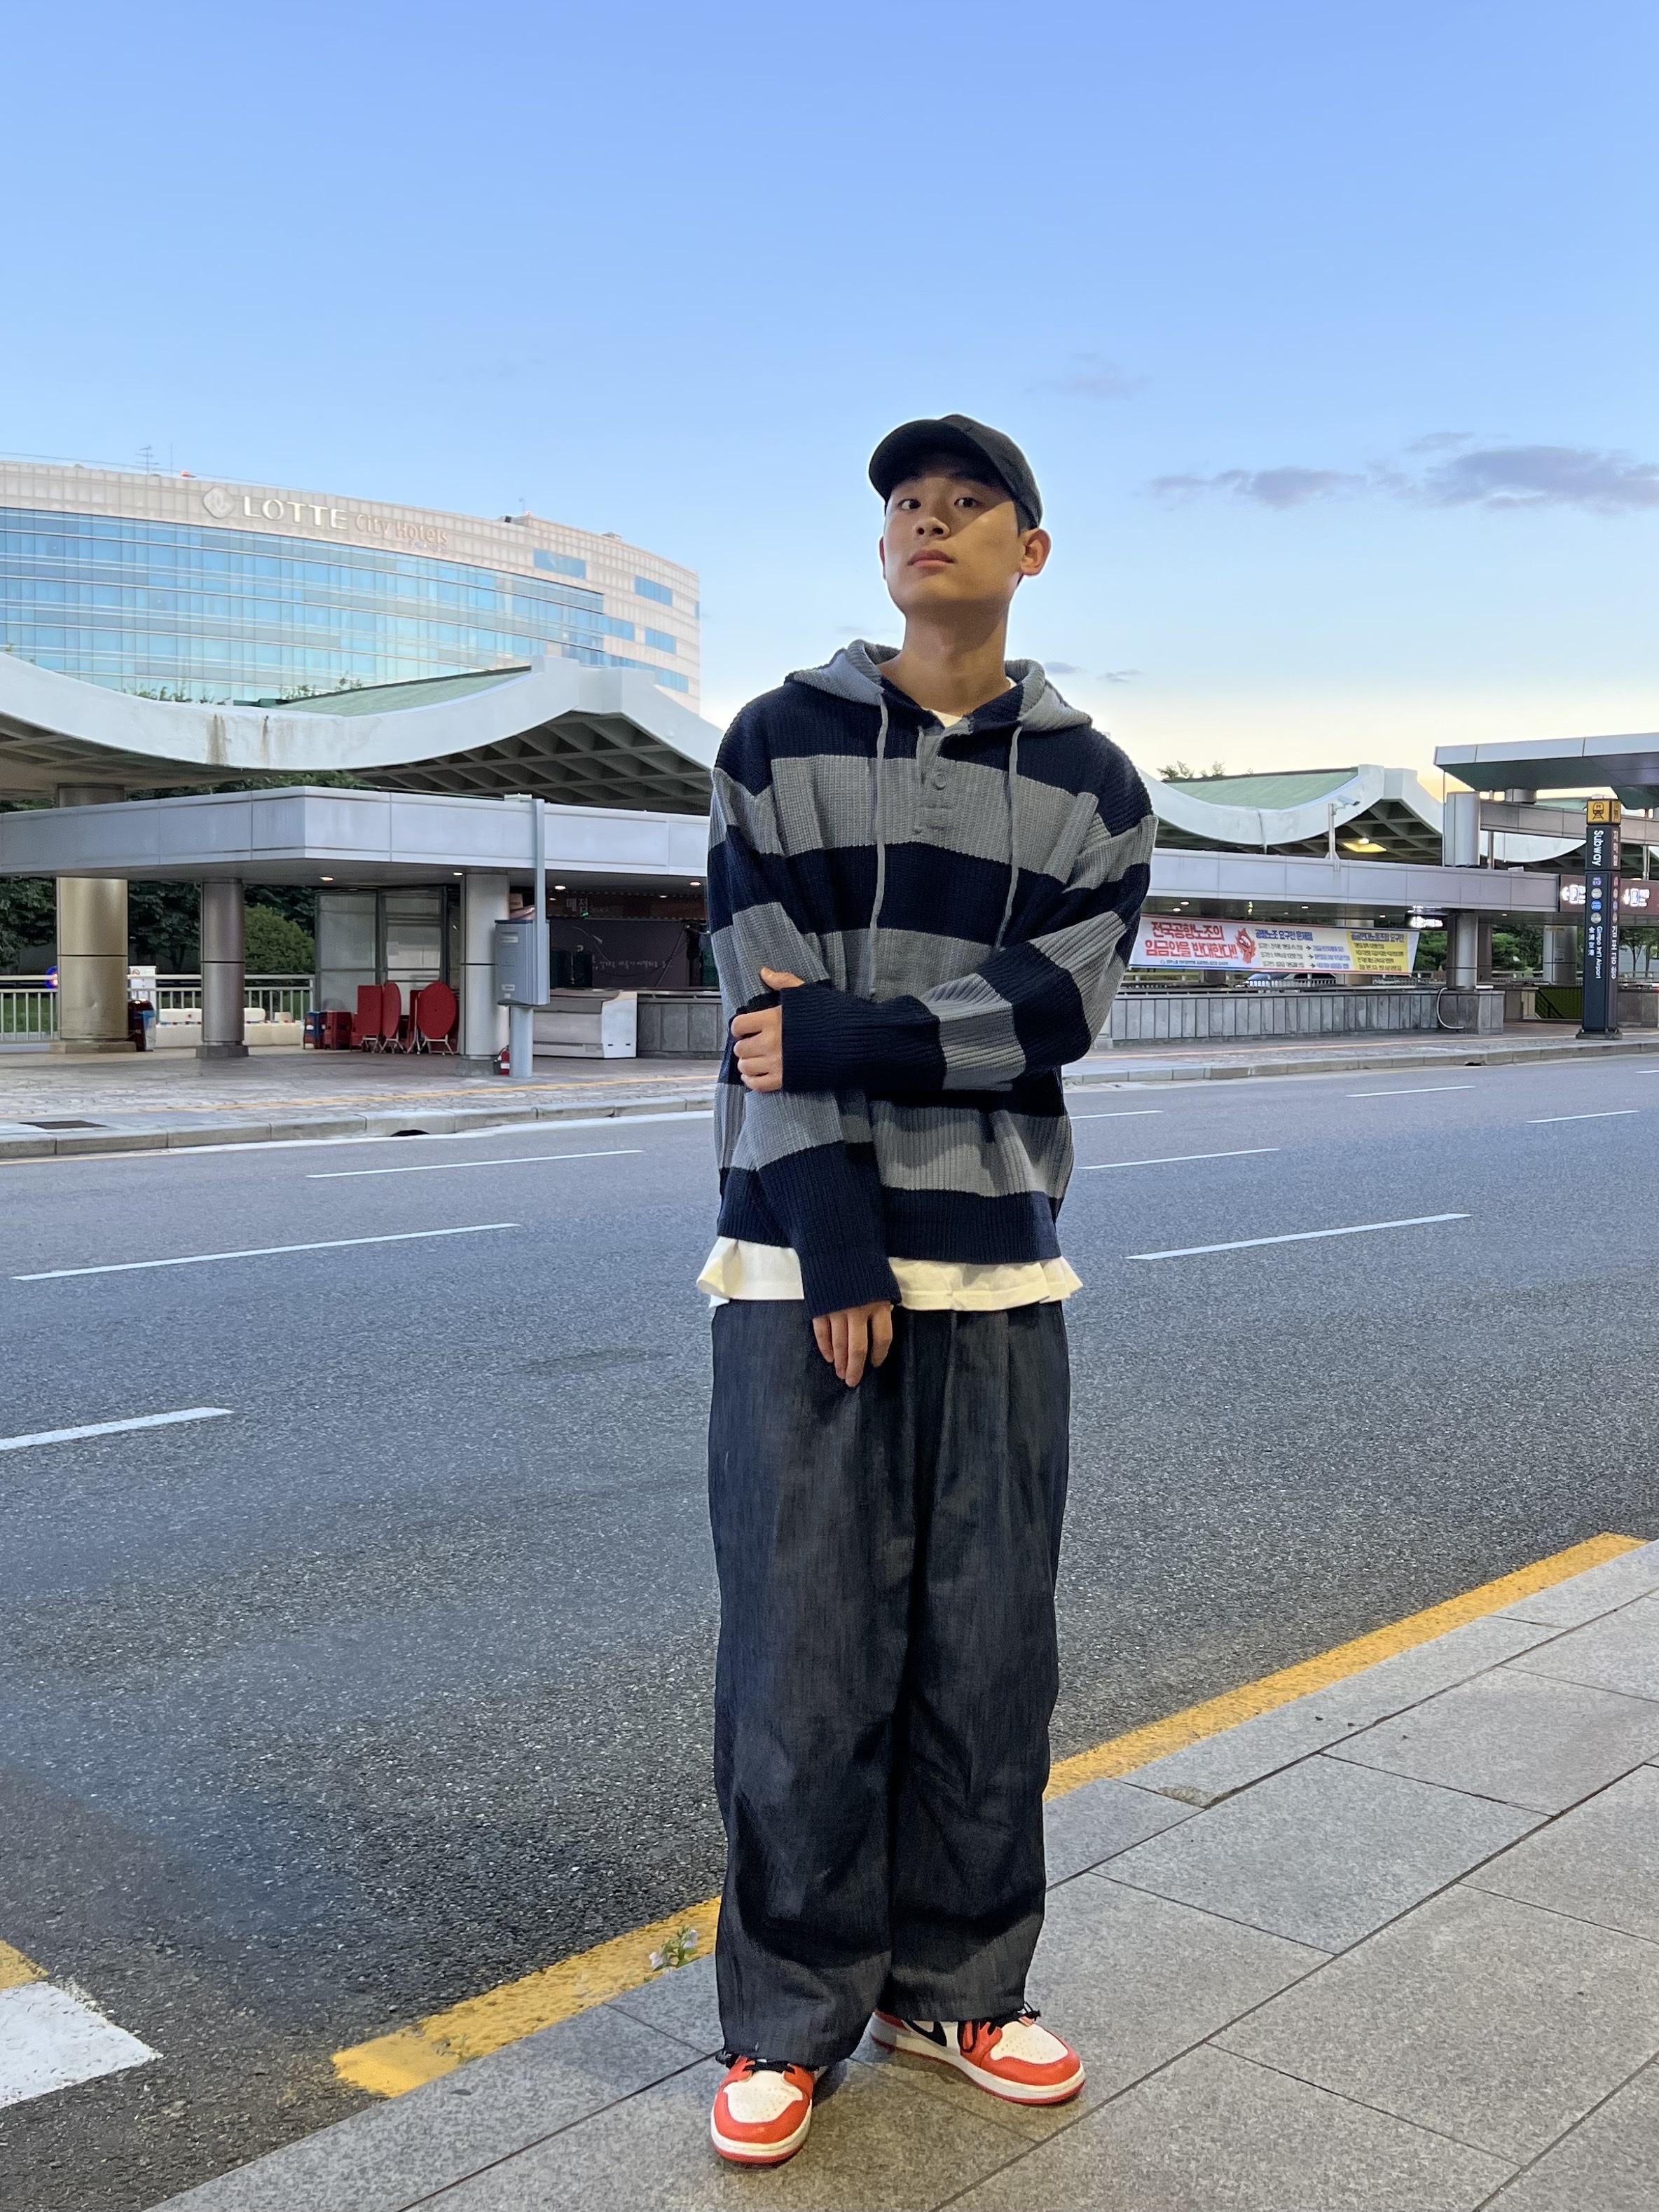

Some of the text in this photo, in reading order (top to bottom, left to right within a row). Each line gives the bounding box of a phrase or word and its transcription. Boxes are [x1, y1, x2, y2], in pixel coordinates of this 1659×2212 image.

[243, 495, 449, 546] LOTTE City Hotels
[1591, 830, 1604, 867] Subway
[566, 898, 588, 914] 매점
[1151, 921, 1225, 941] 전국공항노조의
[1145, 940, 1192, 958] 임금안을
[1191, 942, 1239, 959] 반대한다!!
